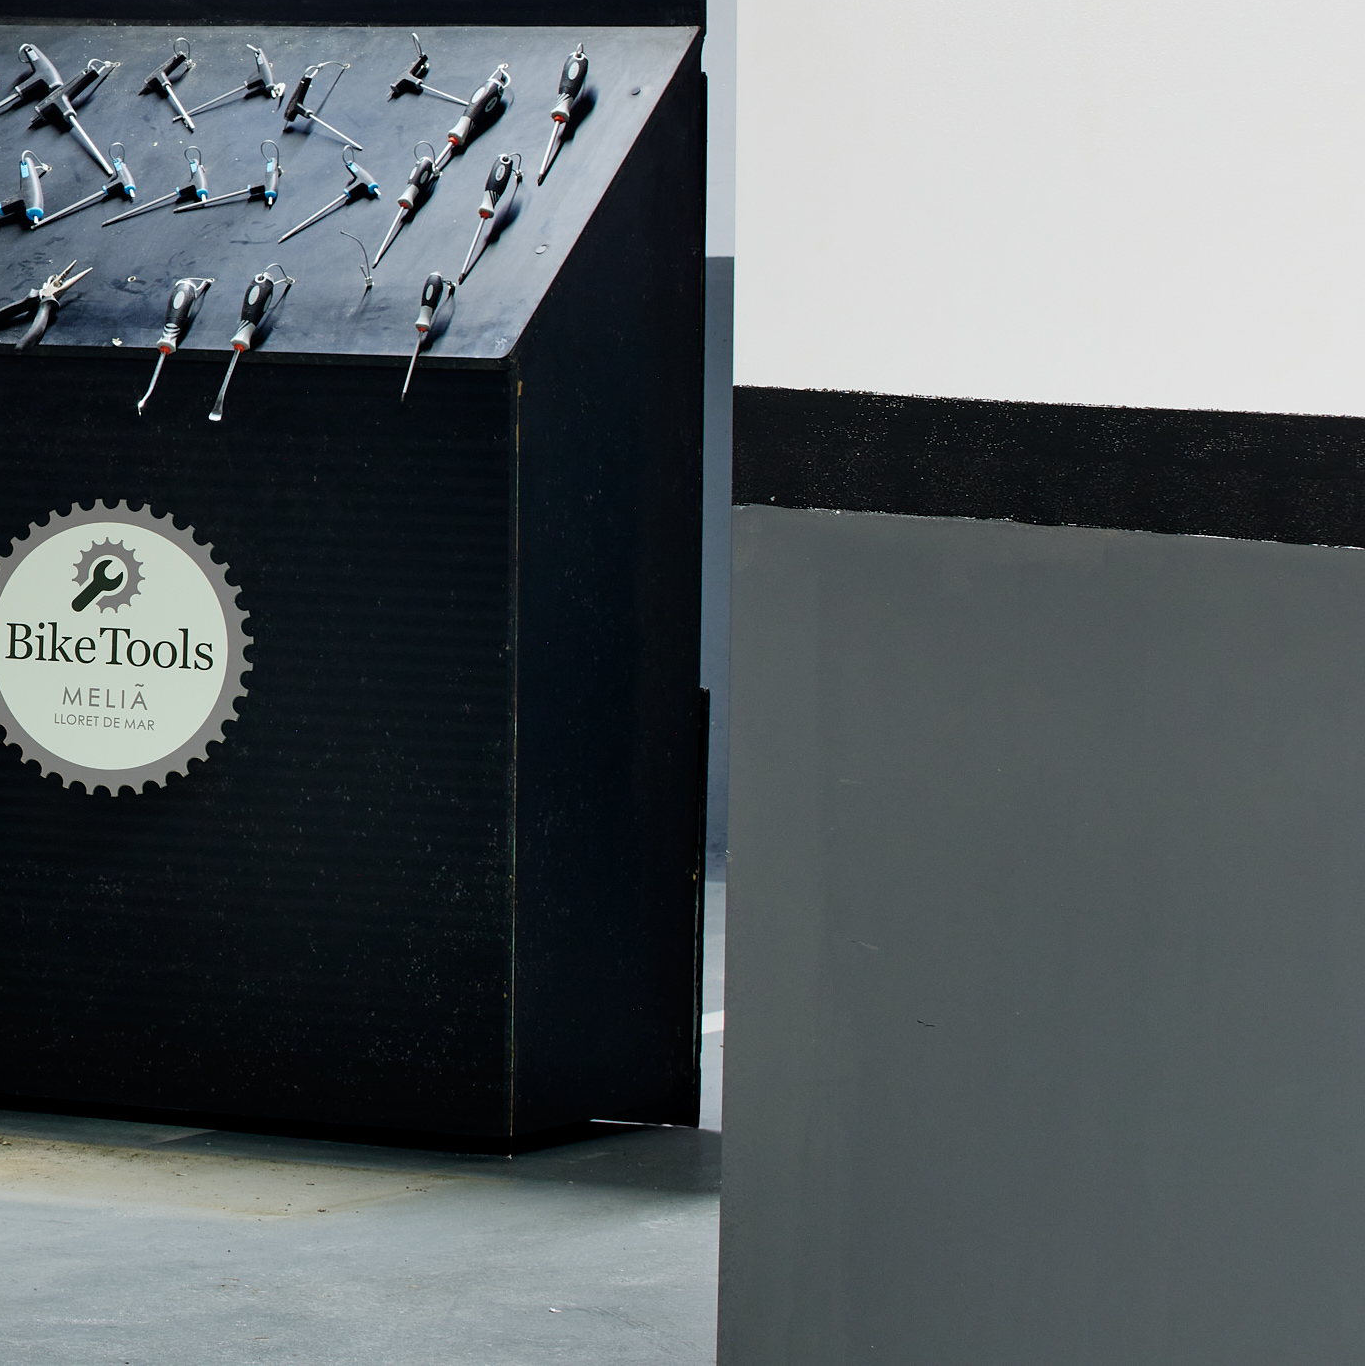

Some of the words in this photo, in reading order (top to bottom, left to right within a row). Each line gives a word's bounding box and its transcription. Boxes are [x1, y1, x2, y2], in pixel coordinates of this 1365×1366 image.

[55, 713, 99, 726] LLORET
[104, 717, 120, 728] DE
[124, 719, 154, 730] MAR
